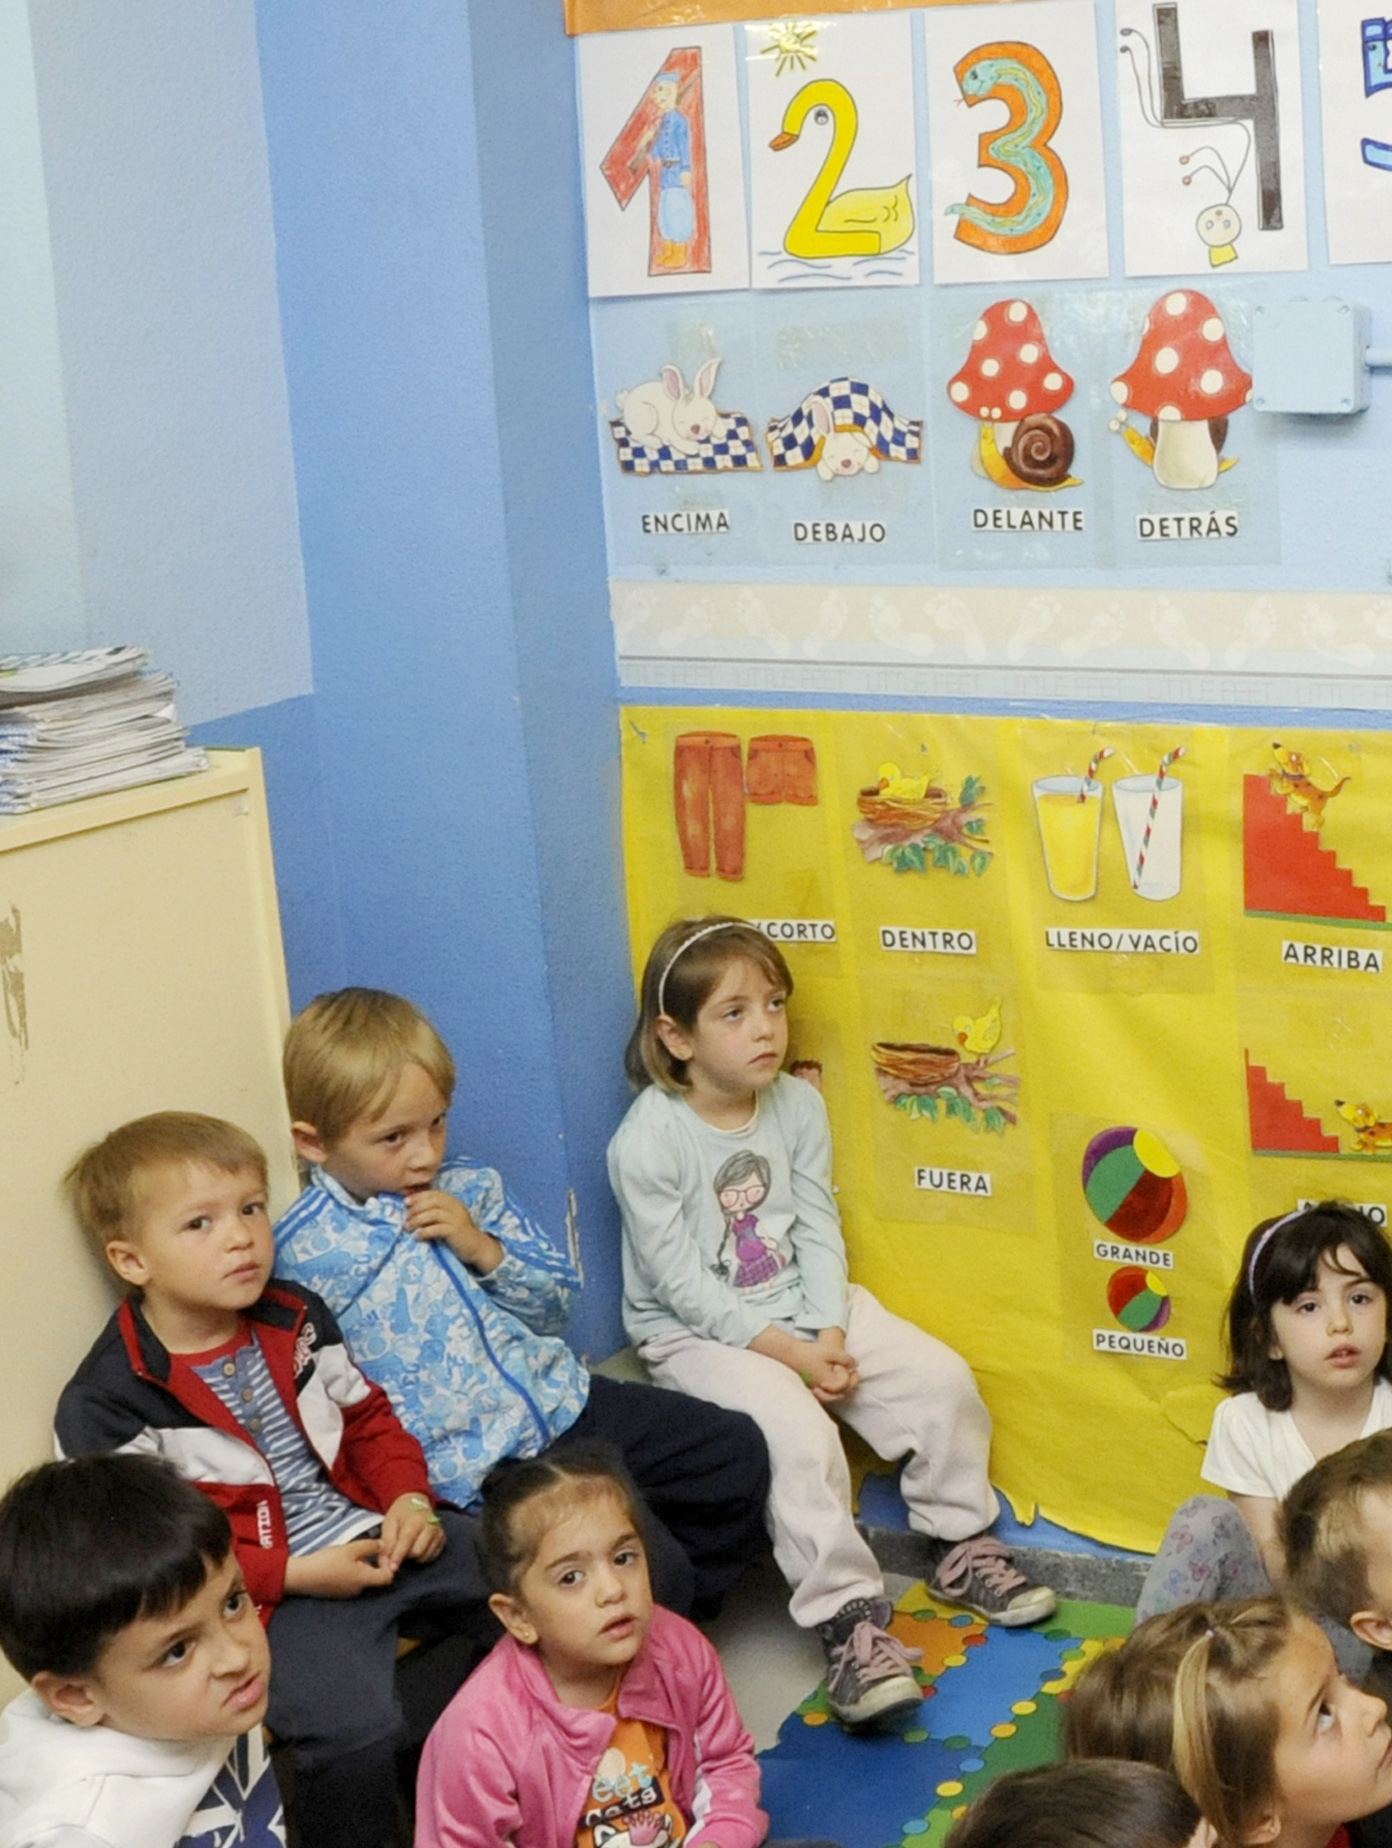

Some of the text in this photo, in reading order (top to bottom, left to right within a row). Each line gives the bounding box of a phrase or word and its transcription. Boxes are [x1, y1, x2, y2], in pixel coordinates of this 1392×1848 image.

[1153, 2, 1284, 231] 4
[952, 41, 1069, 254] 3
[600, 46, 711, 277] 1
[783, 79, 882, 259] 2
[642, 512, 730, 534] ENCIMA
[794, 522, 886, 543] DEBAJO
[973, 509, 1083, 531] DELANTE
[1139, 511, 1238, 538] DETRÁS
[881, 929, 973, 951] DENTRO
[1046, 931, 1198, 953] LLENO/VACÍO
[1284, 943, 1380, 973] ARRIBA
[917, 1168, 989, 1194] FUERA
[1096, 1243, 1171, 1267] GRANDE
[1096, 1333, 1185, 1357] PEQUEÑO
